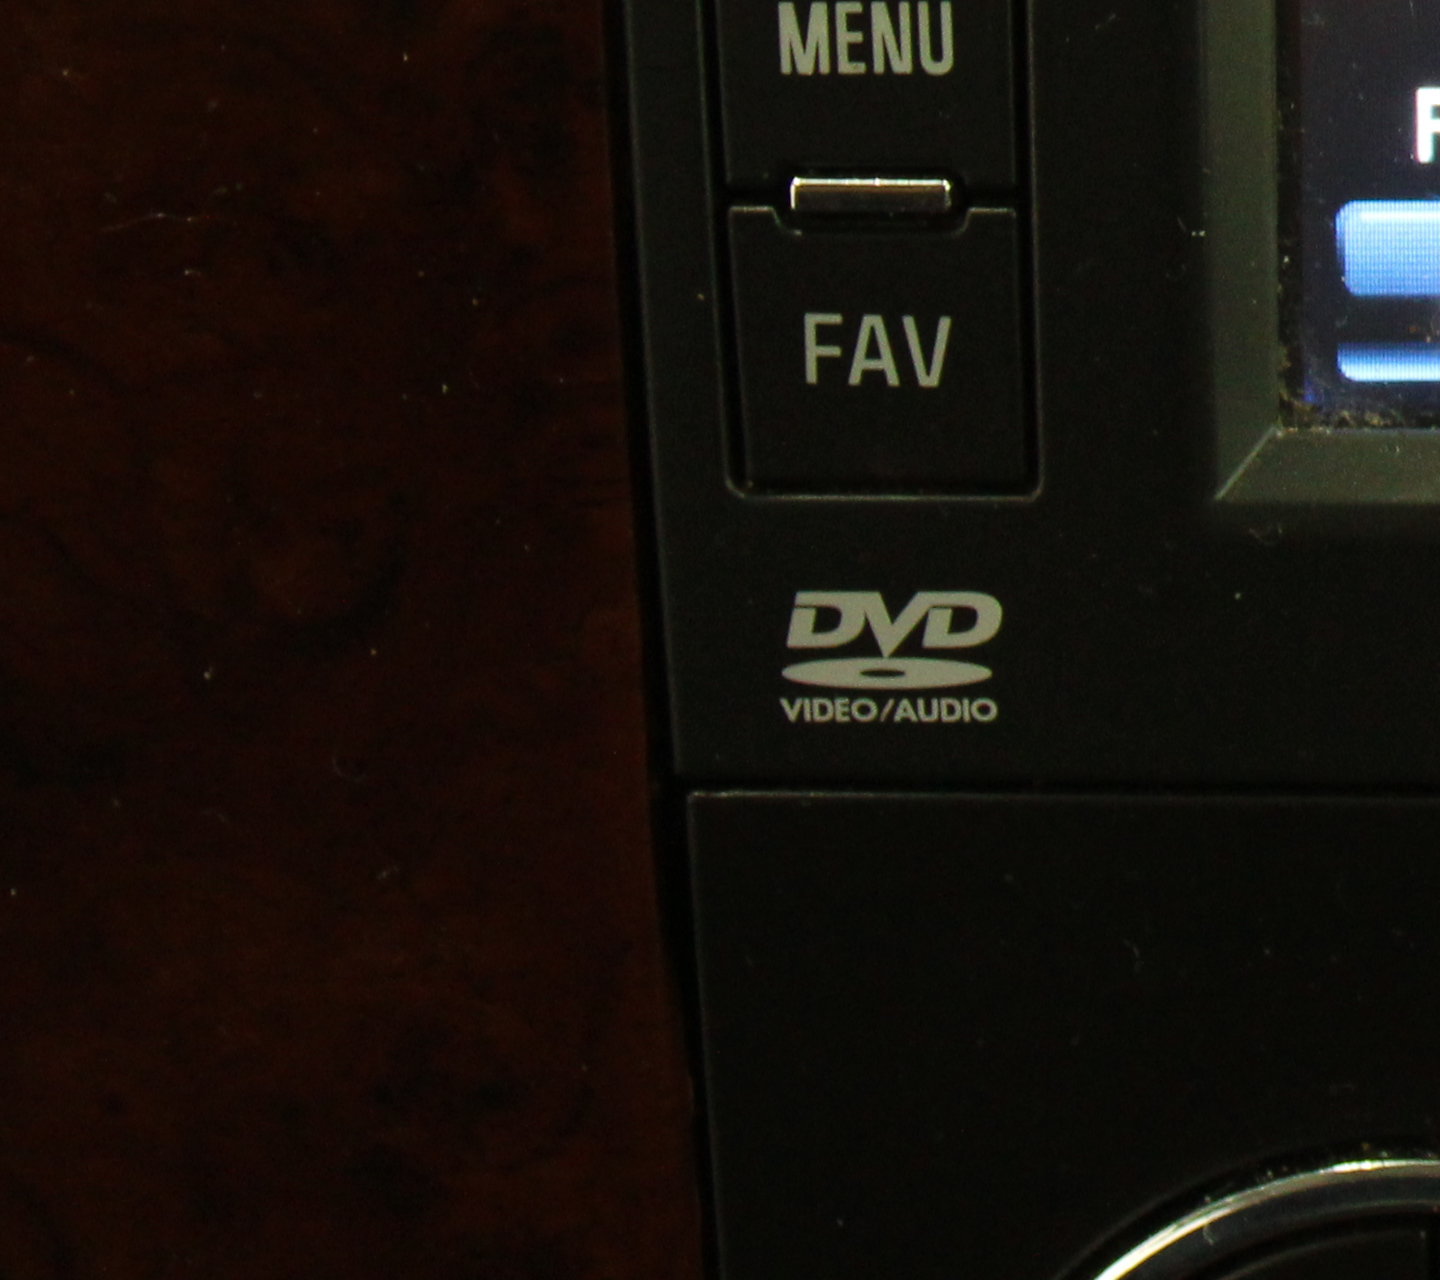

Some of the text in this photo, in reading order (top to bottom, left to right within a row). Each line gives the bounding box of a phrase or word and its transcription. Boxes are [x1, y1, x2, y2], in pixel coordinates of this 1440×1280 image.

[778, 0, 956, 78] MENU
[803, 314, 952, 389] FAV
[786, 591, 1002, 658] DVD
[779, 698, 997, 722] VIDEO/AUDIO
